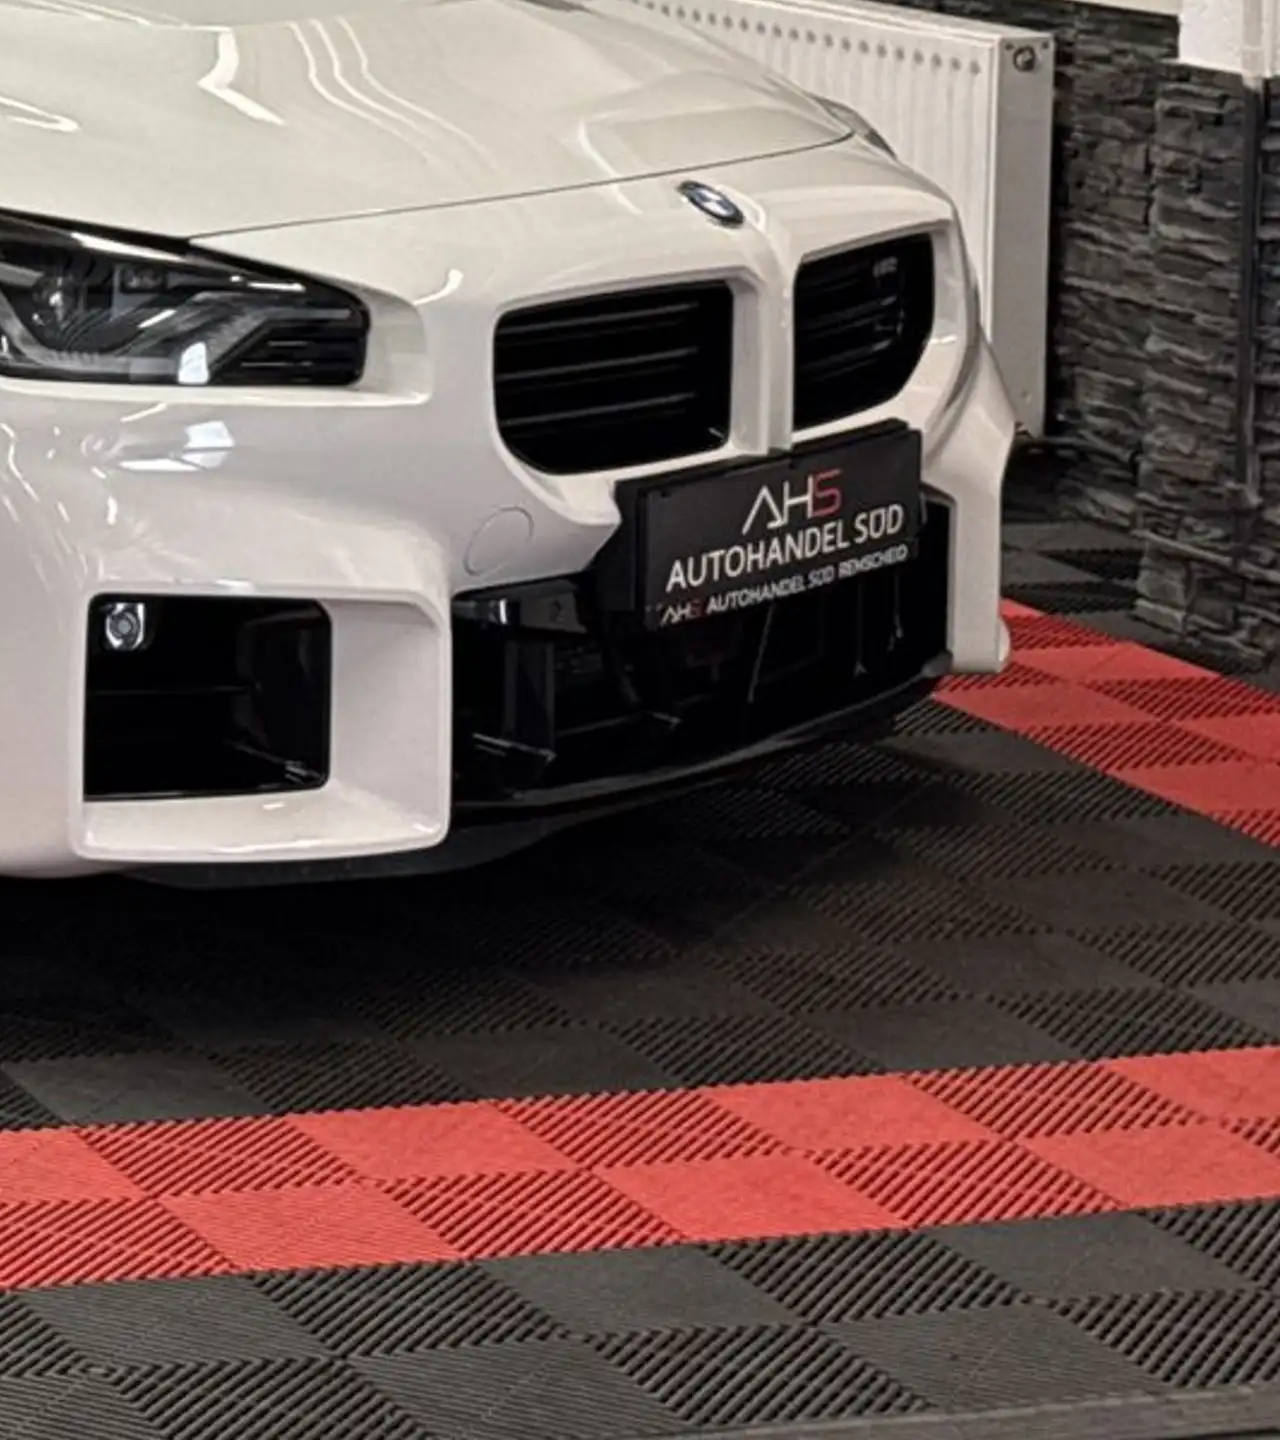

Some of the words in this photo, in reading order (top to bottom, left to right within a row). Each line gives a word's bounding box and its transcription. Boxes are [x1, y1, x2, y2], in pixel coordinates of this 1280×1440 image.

[742, 468, 842, 536] AHS
[666, 519, 849, 592] AUTOHANDEL
[854, 504, 904, 543] SÜD
[706, 576, 806, 614] AUTOHANDEL
